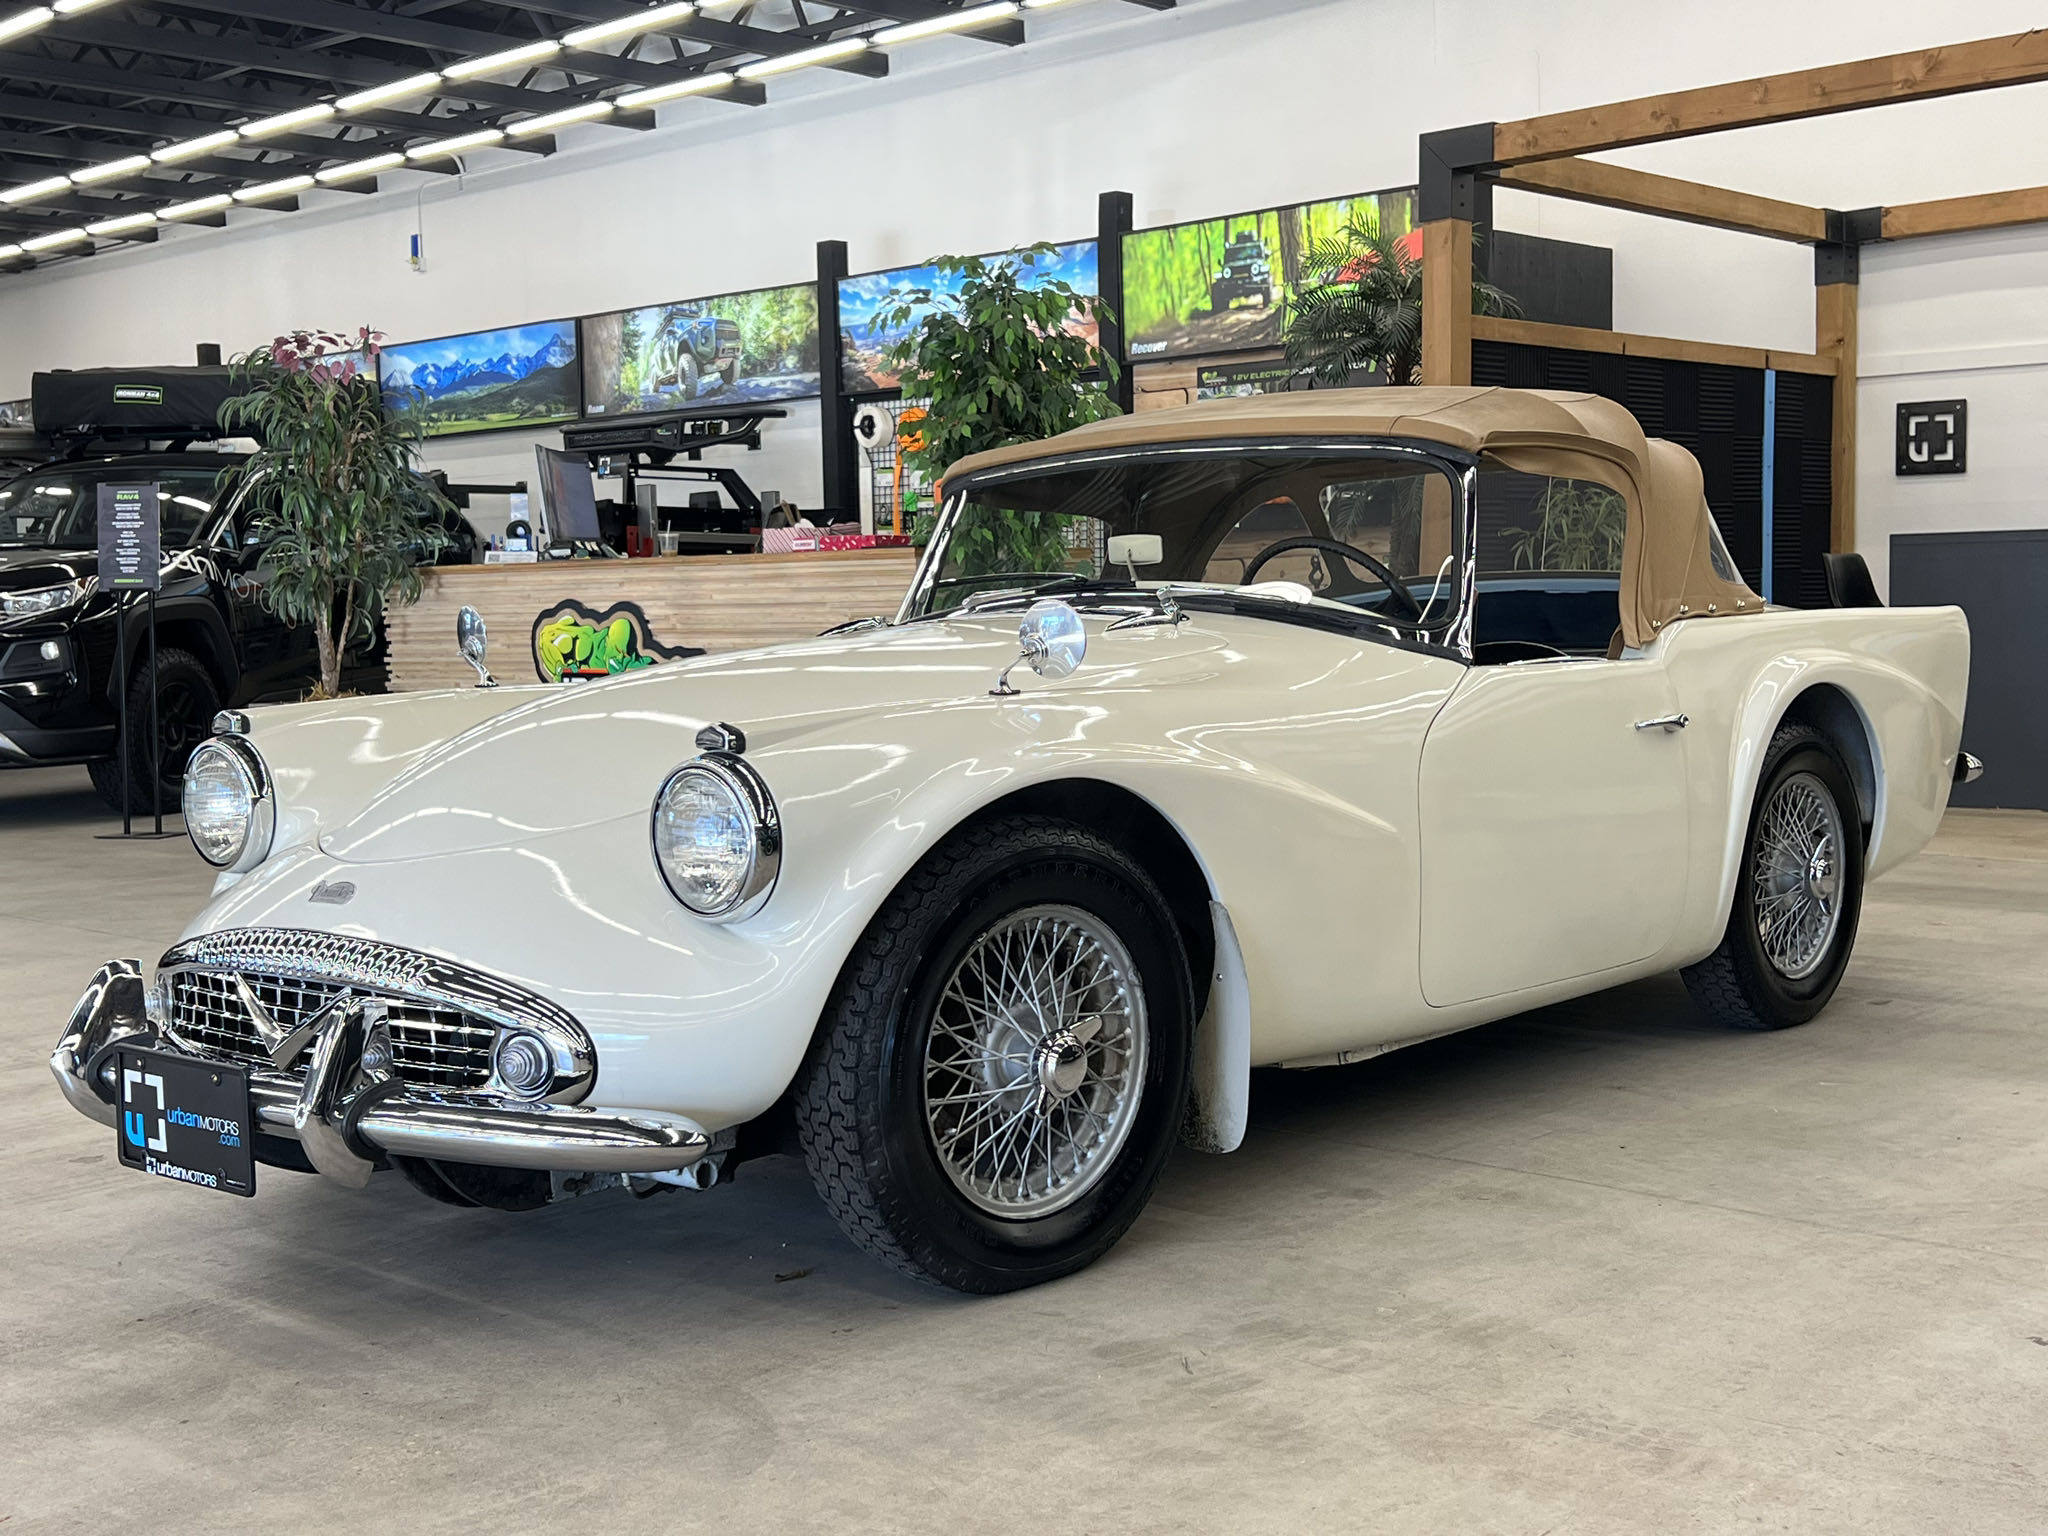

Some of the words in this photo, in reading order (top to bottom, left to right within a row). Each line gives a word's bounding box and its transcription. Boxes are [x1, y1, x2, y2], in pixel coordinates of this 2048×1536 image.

[1131, 341, 1167, 355] Recover
[1250, 369, 1291, 380] ELECTRIC
[167, 1106, 240, 1136] urbanMOTORS
[218, 1133, 241, 1148] .com
[157, 1161, 218, 1188] urbanMOTORS
